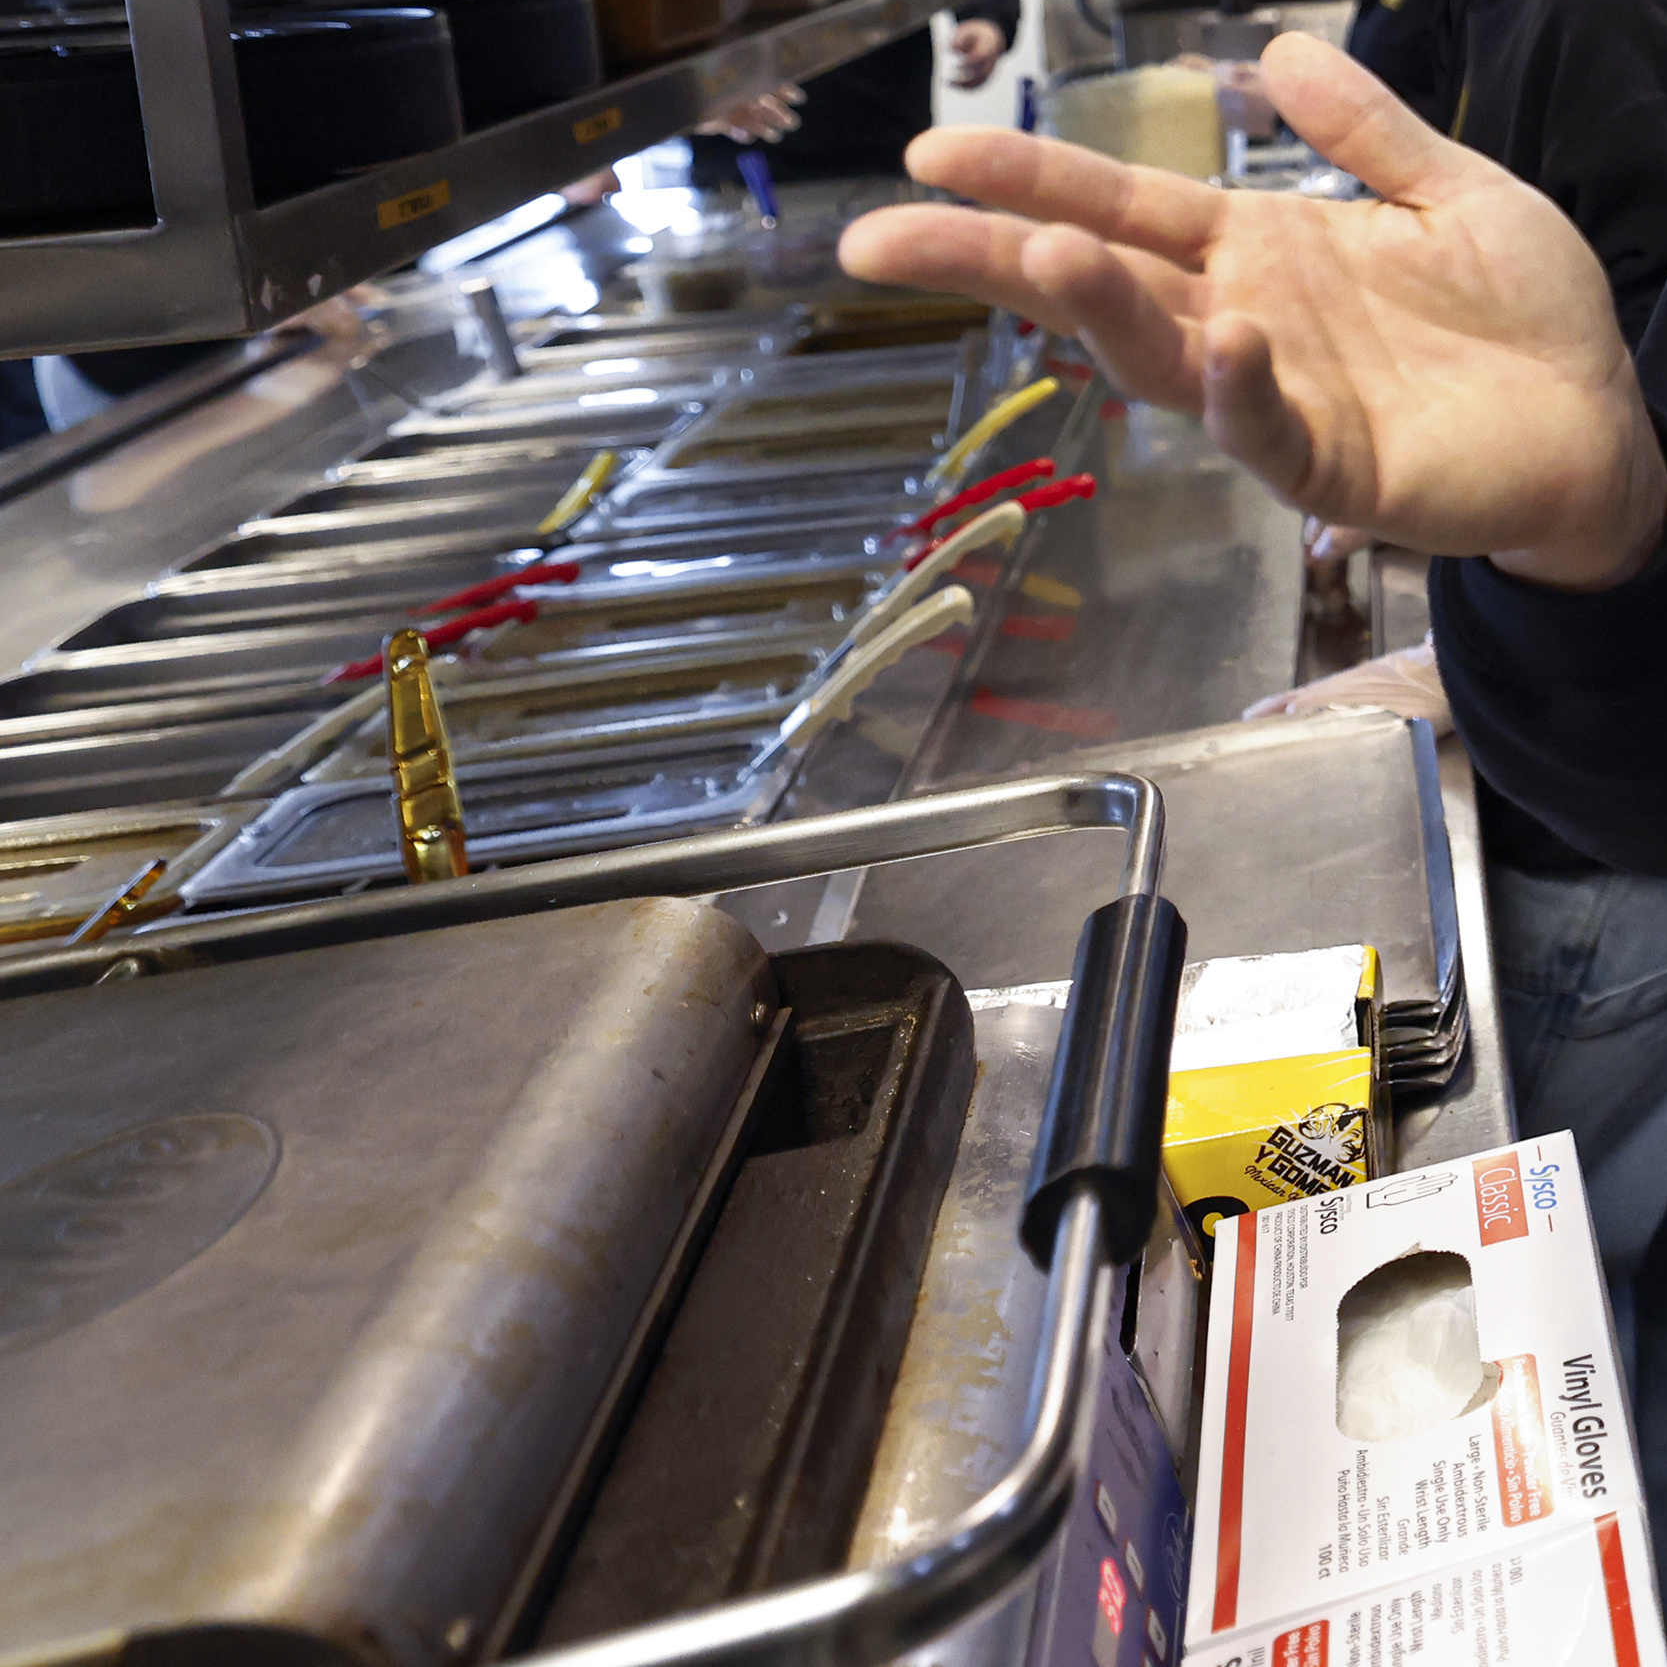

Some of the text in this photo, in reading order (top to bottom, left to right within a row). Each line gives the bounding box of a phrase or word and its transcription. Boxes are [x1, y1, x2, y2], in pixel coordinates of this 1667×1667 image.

[1254, 1145, 1266, 1164] Y
[1268, 1155, 1332, 1196] GOME
[1267, 1126, 1356, 1188] GUZMAN
[1244, 1164, 1286, 1198] Mexican
[1479, 1166, 1520, 1229] Classic
[1524, 1165, 1560, 1209] Sysco
[1274, 1212, 1282, 1236] PRODUCT
[1300, 1205, 1309, 1235] DISTRIBUTED
[1315, 1197, 1343, 1234] Sysco
[1286, 1224, 1294, 1262] CORPORATION,
[1285, 1262, 1294, 1289] HOUSTON,
[1299, 1278, 1308, 1289] POR
[1272, 1298, 1280, 1315] CHINA
[1285, 1289, 1294, 1305] TEXAS
[1558, 1354, 1608, 1499] Vinyl Gloves
[1467, 1434, 1490, 1532] Large Non-Sterile
[1506, 1475, 1520, 1492] Sin
[1522, 1451, 1539, 1490] Powder
[1356, 1449, 1371, 1567] Ambidiestro Un Solo Uso
[1414, 1479, 1432, 1550] Wrist Length
[1432, 1460, 1452, 1544] Single Use Only
[1452, 1463, 1468, 1538] Ambidextrous
[1508, 1494, 1524, 1522] Polvo
[1528, 1493, 1542, 1517] Free
[1337, 1469, 1351, 1573] Puño Hasta la Muñeca
[1376, 1496, 1391, 1561] Sin Esterilizar
[1397, 1519, 1412, 1556] Grande
[1318, 1544, 1332, 1580] 100 ct
[1469, 1569, 1482, 1584] Uso
[1509, 1556, 1524, 1585] 100 ct
[1387, 1597, 1405, 1621] Only
[1429, 1583, 1443, 1621] Mediano
[1449, 1577, 1465, 1634] Sin Esterilizar
[1470, 1585, 1484, 1605] Solo
[1471, 1606, 1485, 1620] Un
[1305, 1626, 1320, 1652] Polvo
[1366, 1604, 1382, 1667] mbidextrous
[1388, 1622, 1403, 1640] Use
[1407, 1590, 1426, 1655] Wrist Length
[1494, 1608, 1508, 1635] Hasta
